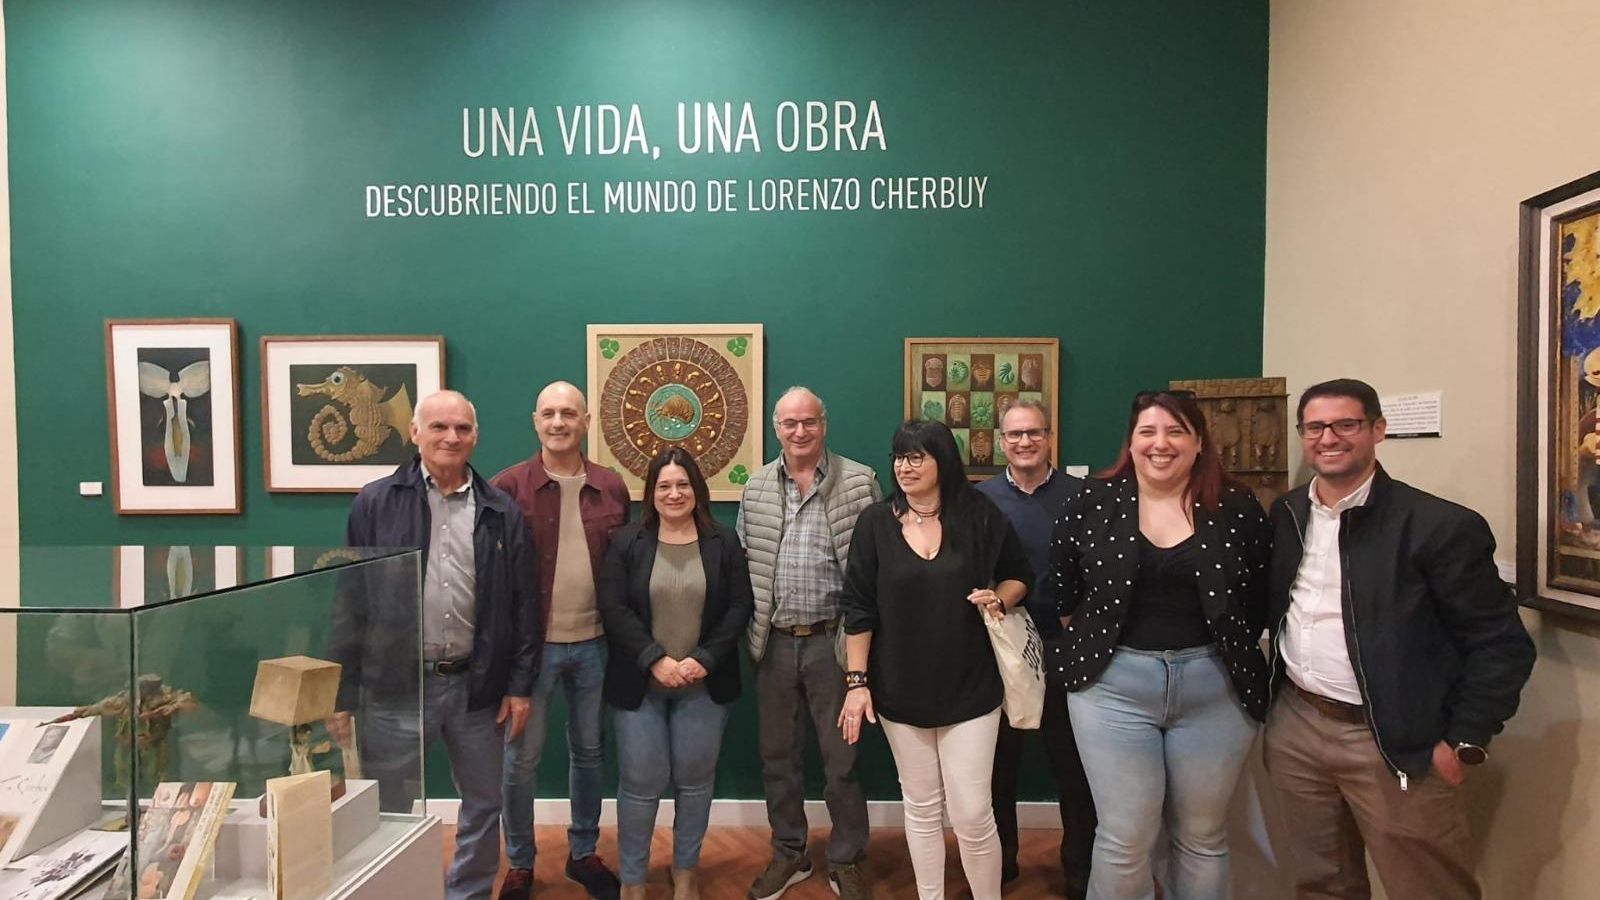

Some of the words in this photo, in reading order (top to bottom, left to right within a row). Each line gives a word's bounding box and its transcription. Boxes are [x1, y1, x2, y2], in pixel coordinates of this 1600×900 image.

[462, 107, 544, 158] UNA
[556, 103, 660, 161] VIDA,
[675, 100, 761, 155] UNA
[777, 100, 887, 153] OBRA
[366, 183, 557, 218] DESCUBRIENDO
[568, 183, 595, 214] EL
[605, 180, 697, 214] MUNDO
[708, 180, 738, 213] DE
[749, 178, 861, 212] LORENZO
[871, 176, 988, 210] CHERBUY
